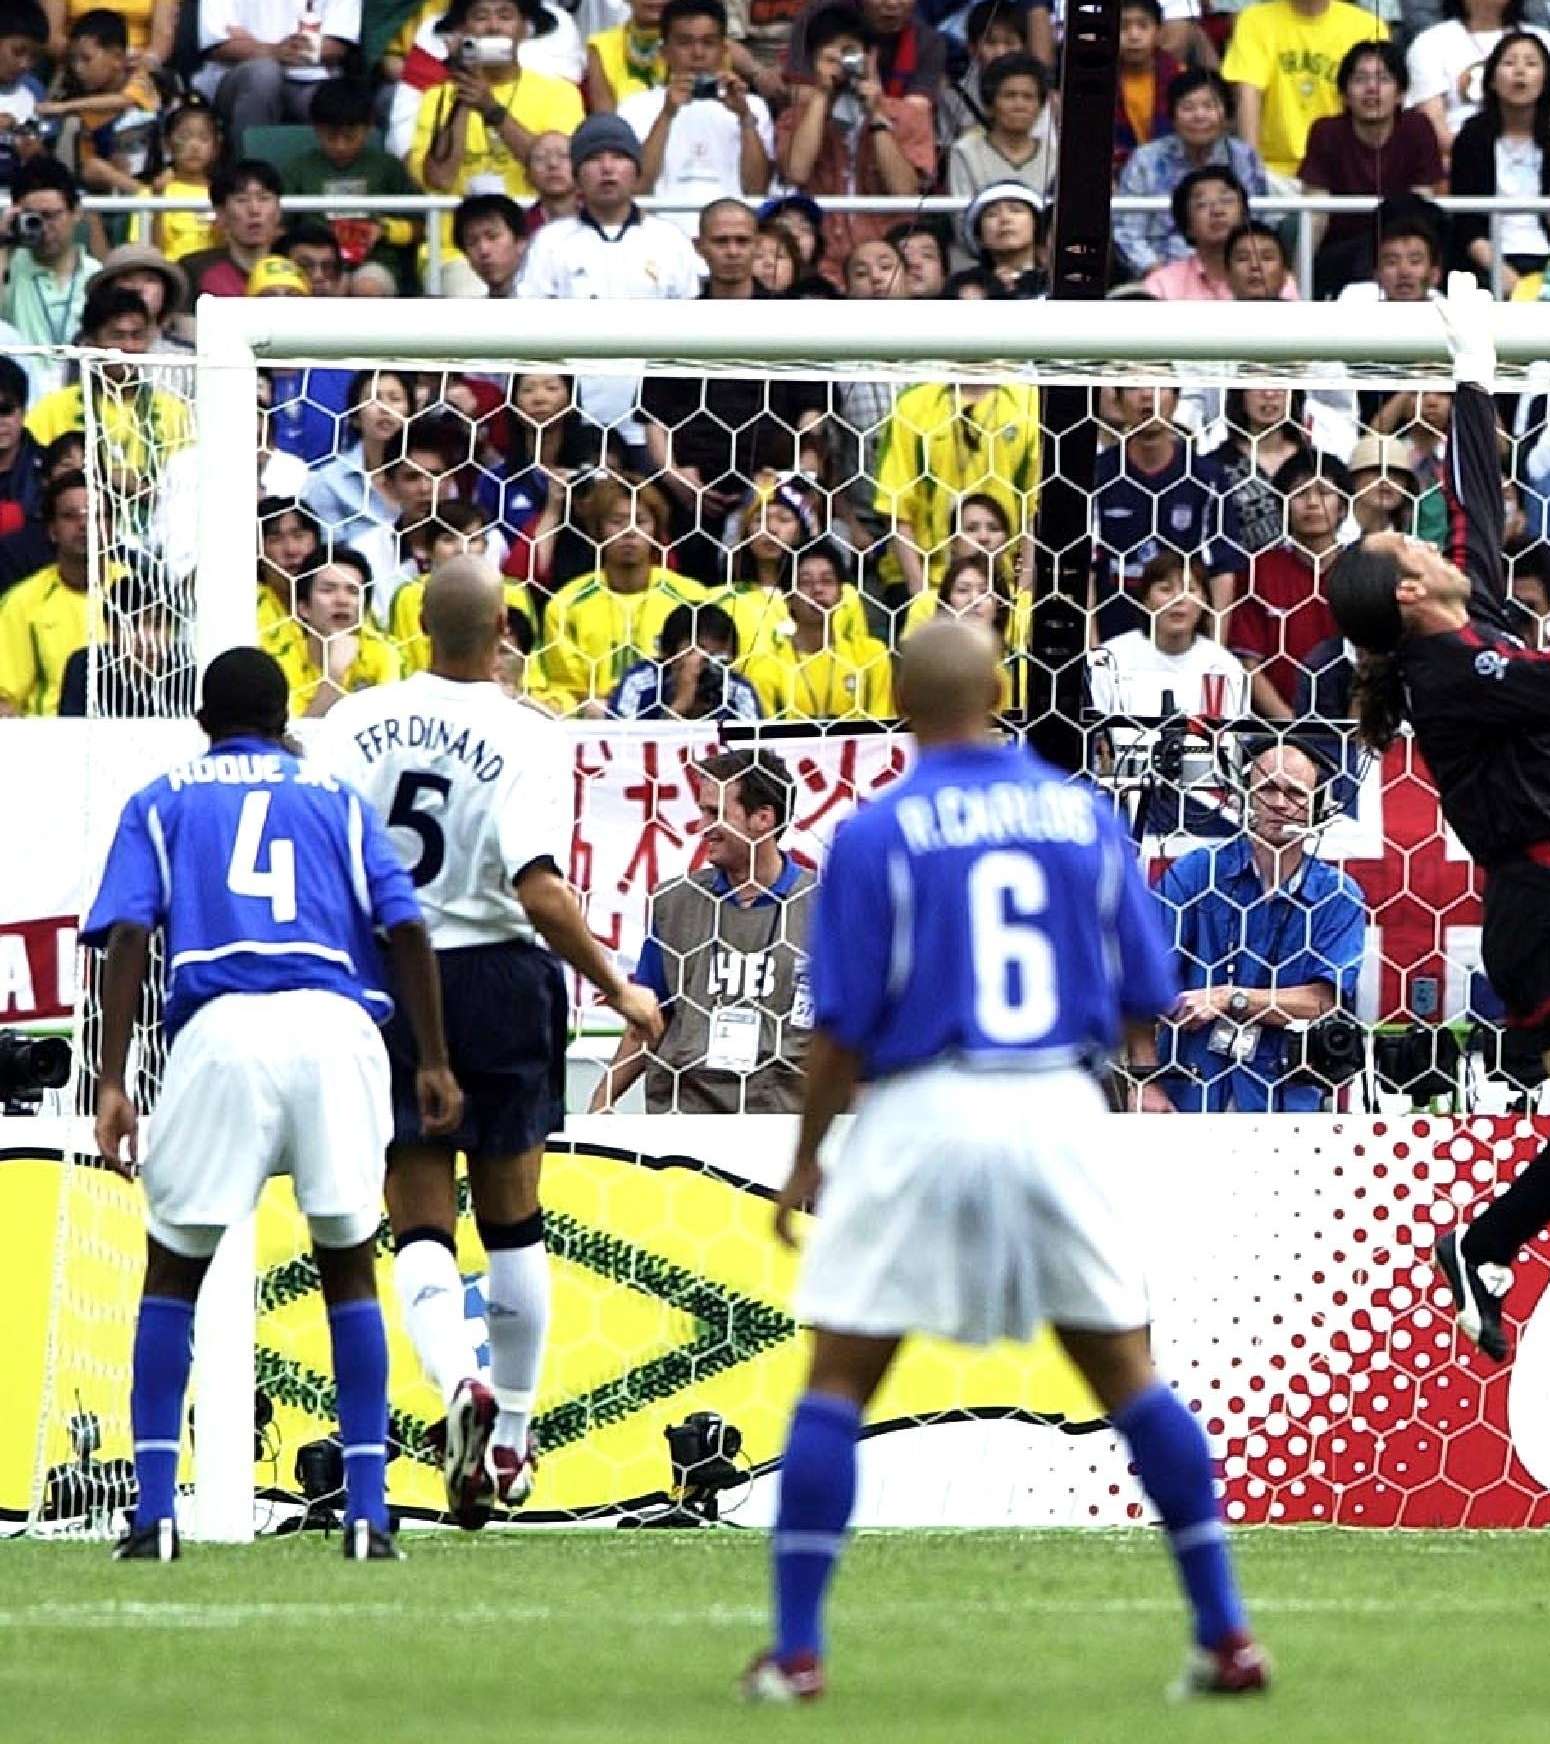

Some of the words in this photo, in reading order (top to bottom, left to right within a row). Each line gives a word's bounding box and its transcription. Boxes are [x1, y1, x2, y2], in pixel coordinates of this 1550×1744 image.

[227, 789, 298, 923] 4
[387, 770, 454, 888] 5
[968, 848, 1060, 1046] 6
